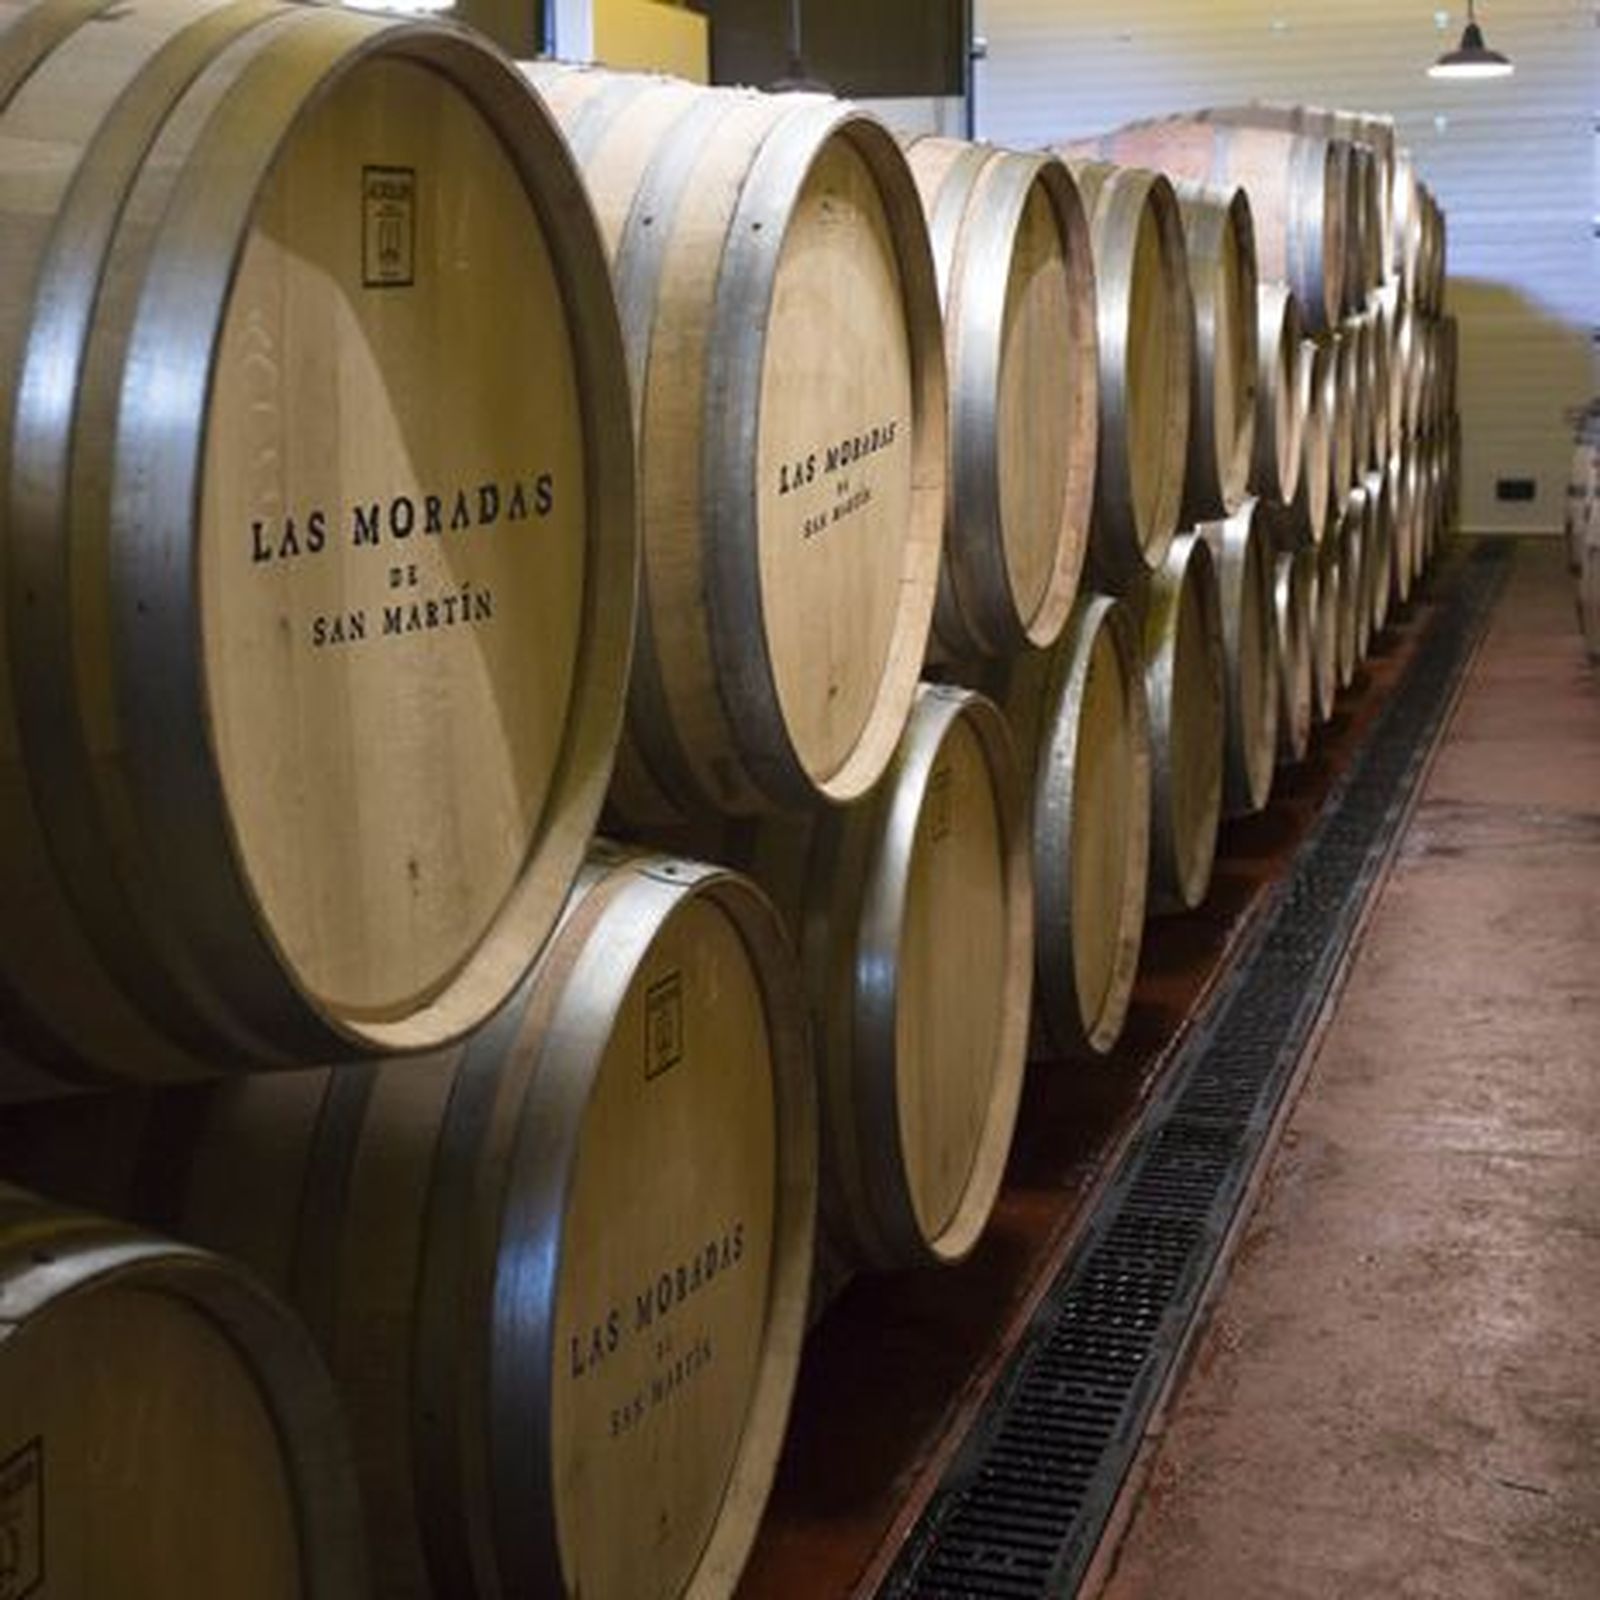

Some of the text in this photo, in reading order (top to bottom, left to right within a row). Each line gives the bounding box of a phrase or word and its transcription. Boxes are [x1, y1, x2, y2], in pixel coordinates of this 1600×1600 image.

[779, 453, 816, 495] LAS
[252, 473, 554, 563] LAS MORADAS
[389, 564, 418, 589] DE
[312, 582, 493, 647] SAN MARTÍN
[571, 1221, 744, 1380] LAS MORADAS
